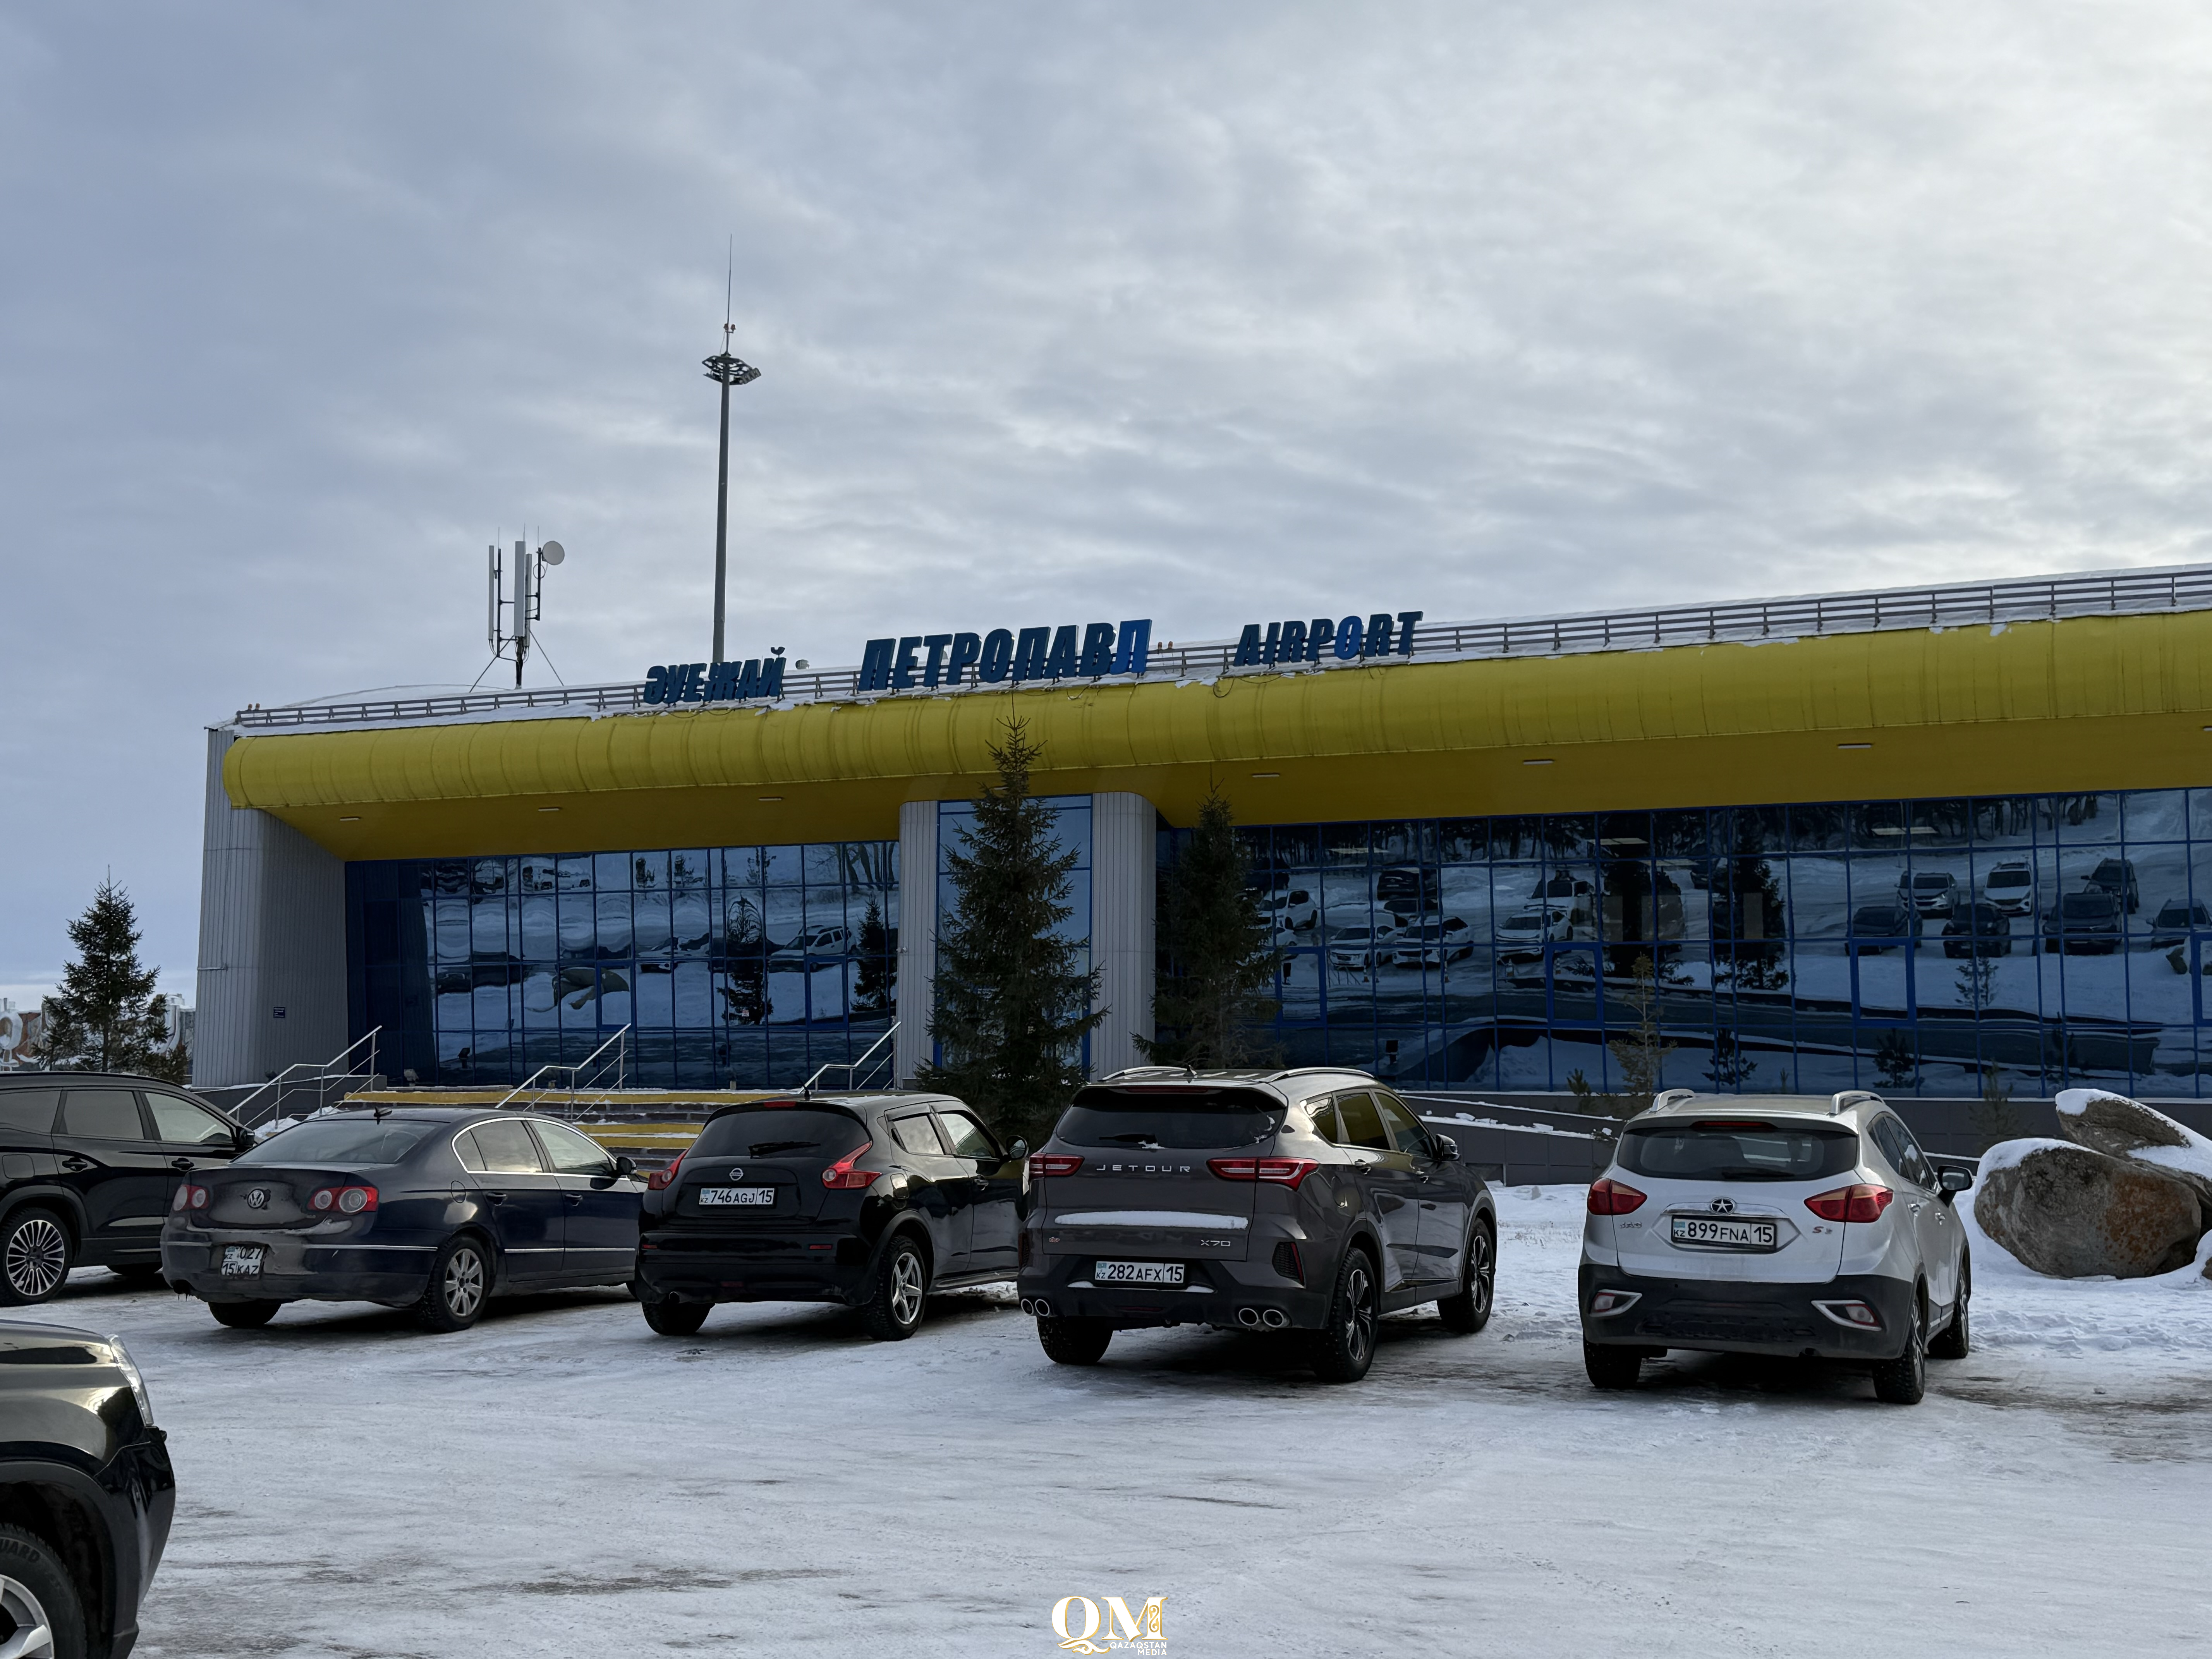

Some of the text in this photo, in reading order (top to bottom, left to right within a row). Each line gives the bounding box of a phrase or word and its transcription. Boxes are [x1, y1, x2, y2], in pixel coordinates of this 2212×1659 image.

[1233, 611, 1424, 667] AIRPORT
[643, 619, 1152, 705] ӘУЕЖАЙ ПЕТРОПАВЛ
[223, 1263, 235, 1275] 15
[240, 1247, 261, 1259] 027
